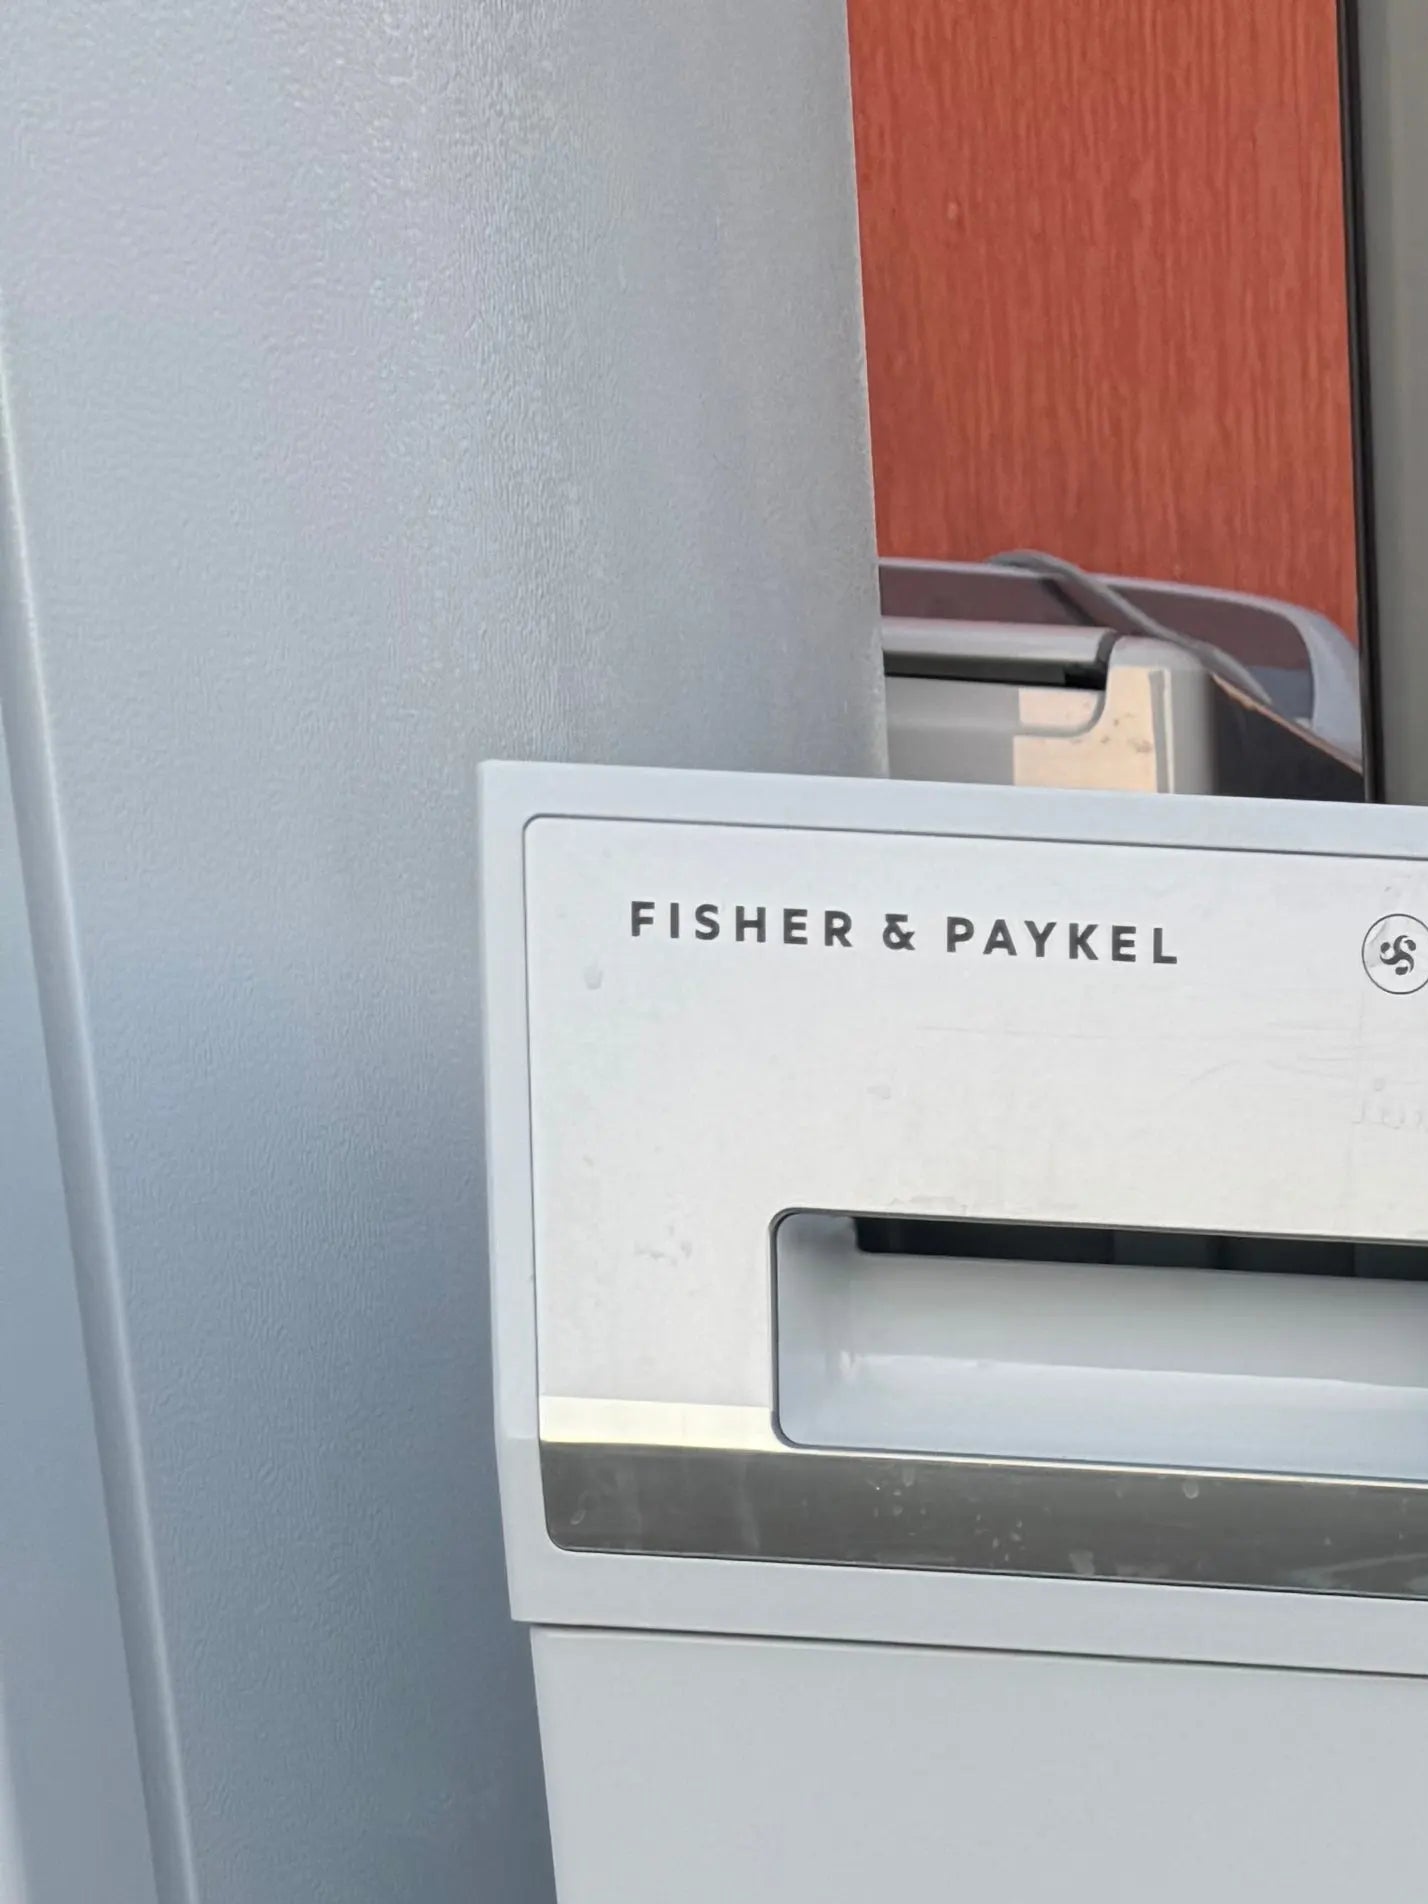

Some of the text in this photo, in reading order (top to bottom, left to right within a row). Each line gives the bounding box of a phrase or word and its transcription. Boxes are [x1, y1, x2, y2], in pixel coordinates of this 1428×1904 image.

[632, 901, 1177, 964] FISHER & PAYKEL
